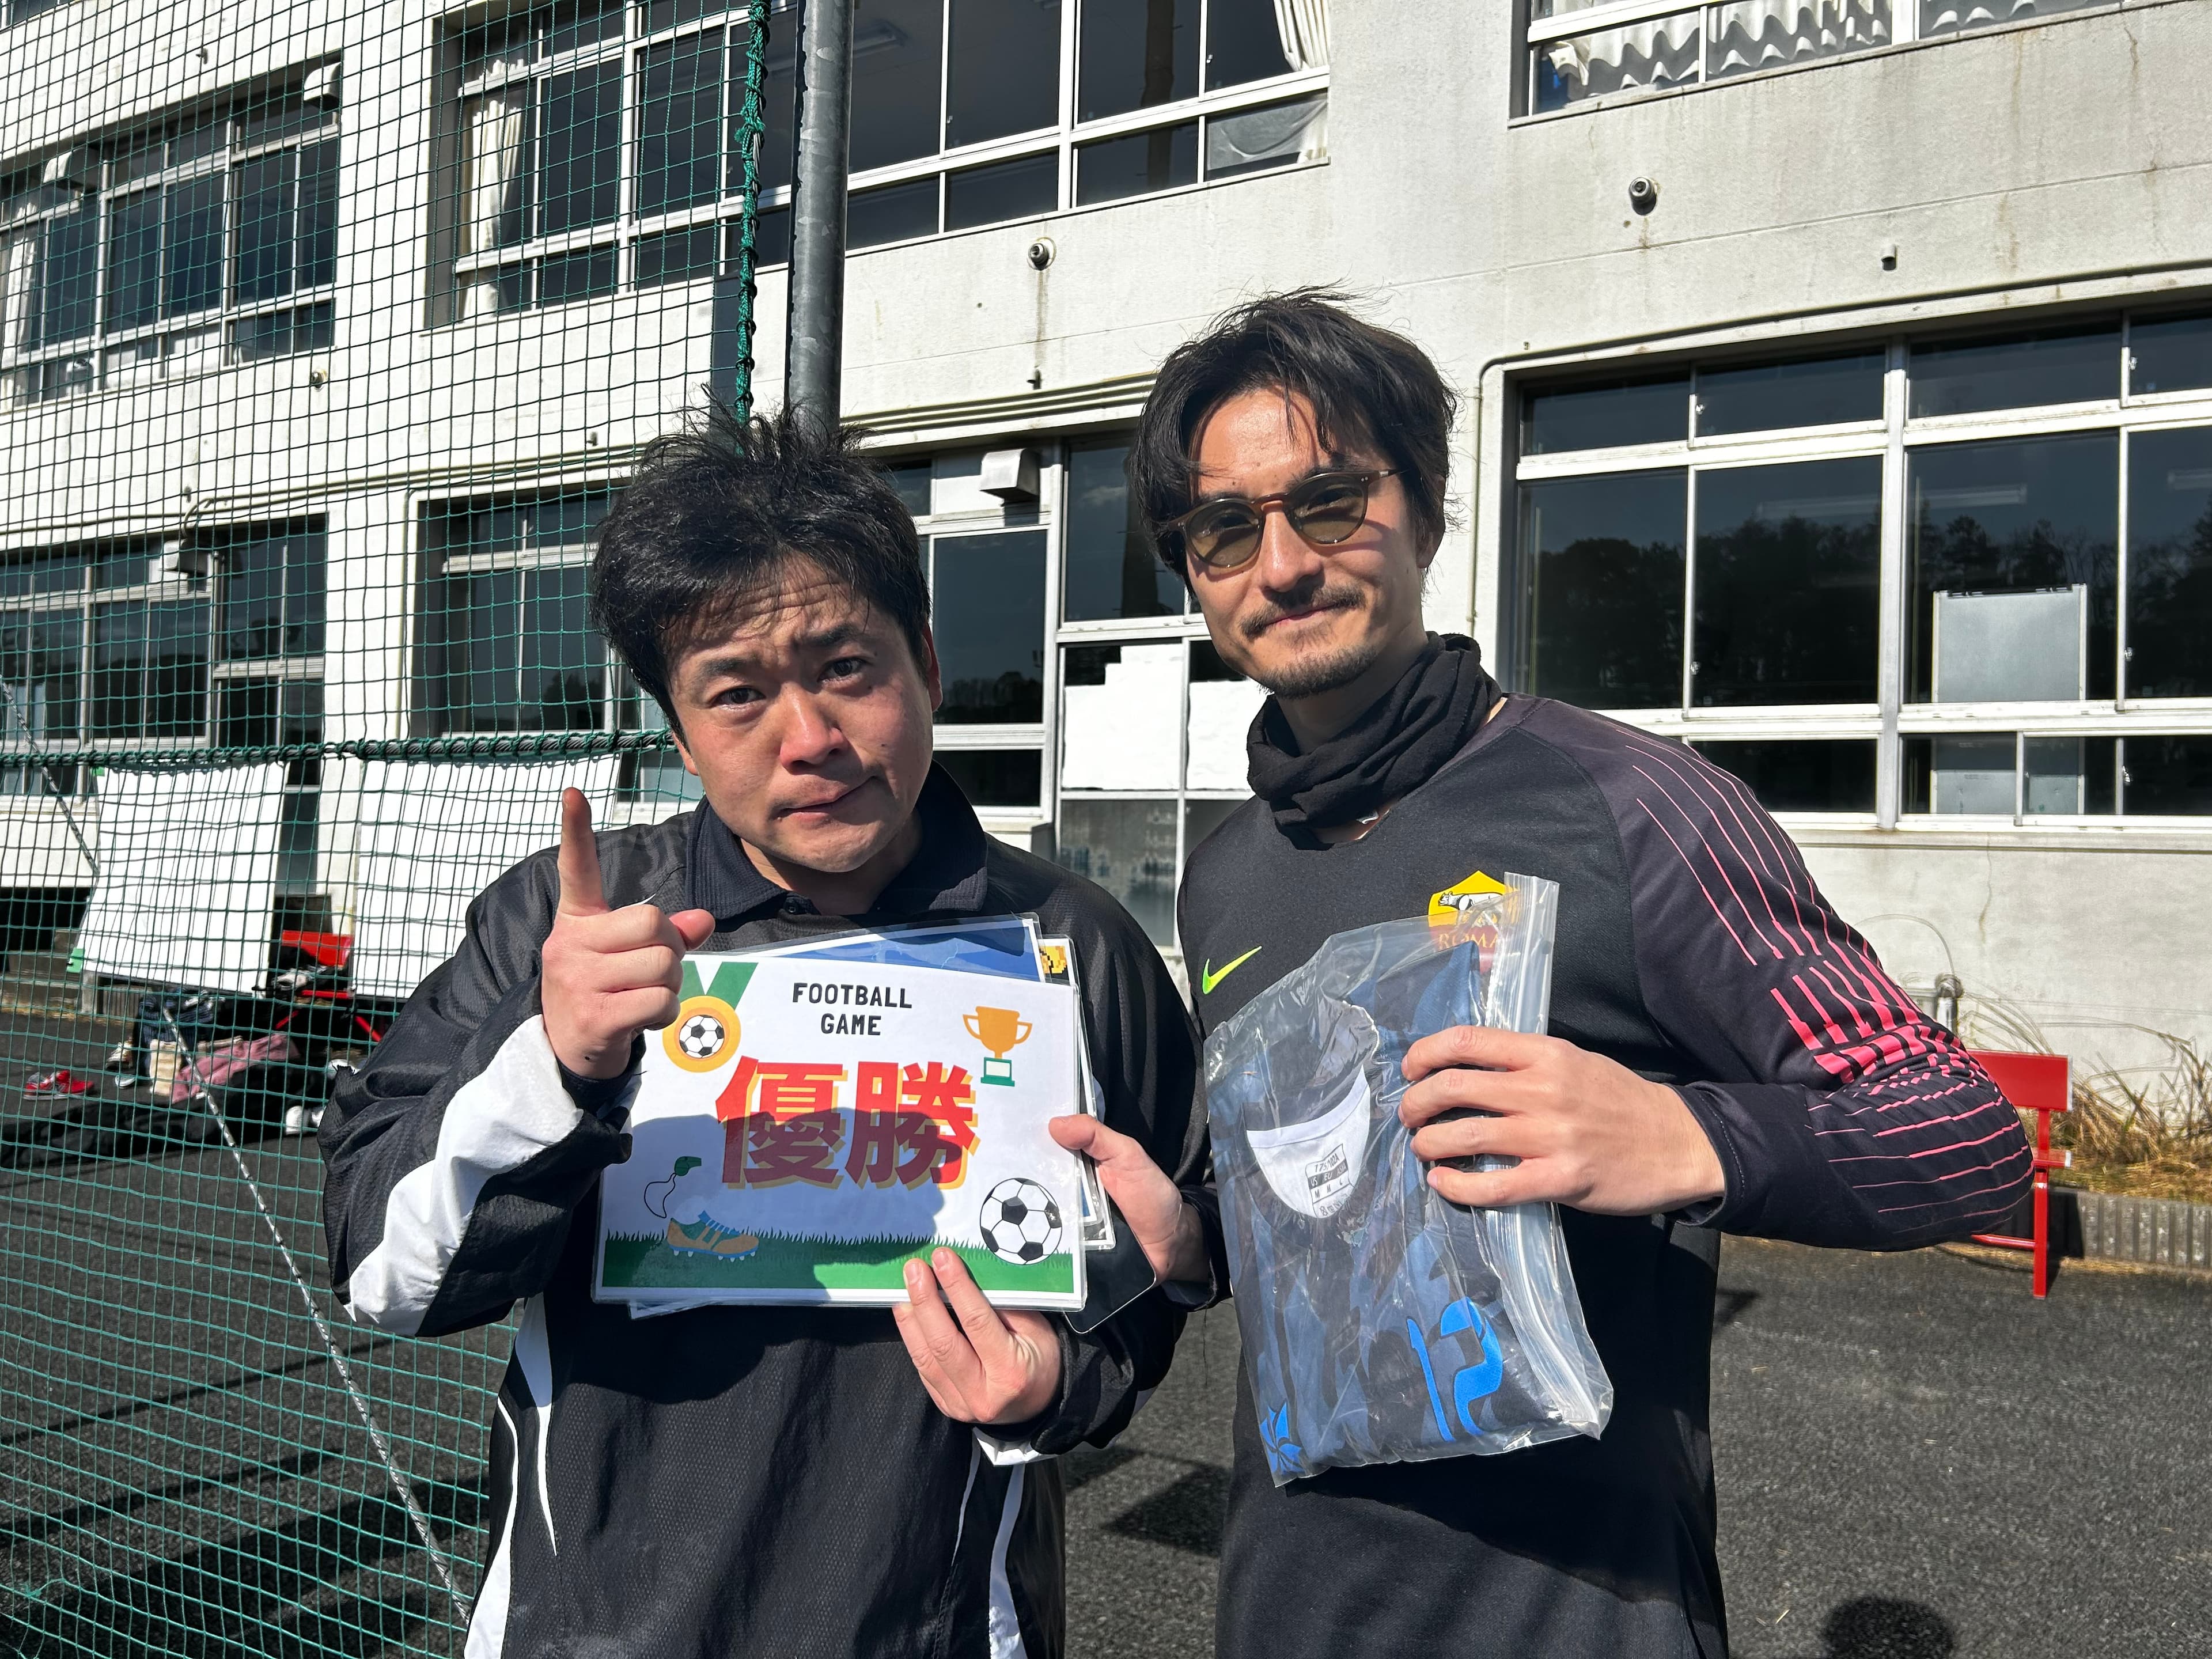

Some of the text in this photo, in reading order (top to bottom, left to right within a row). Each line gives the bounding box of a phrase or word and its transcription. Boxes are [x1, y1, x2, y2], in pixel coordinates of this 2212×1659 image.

[792, 982, 912, 1009] FOOTBALL
[821, 1013, 881, 1036] GAME
[715, 1055, 979, 1190] 優勝
[1310, 1176, 1318, 1187] US
[1324, 1171, 1332, 1181] EU
[1315, 1188, 1320, 1199] M
[1327, 1184, 1331, 1194] M
[1406, 1296, 1503, 1442] 12
